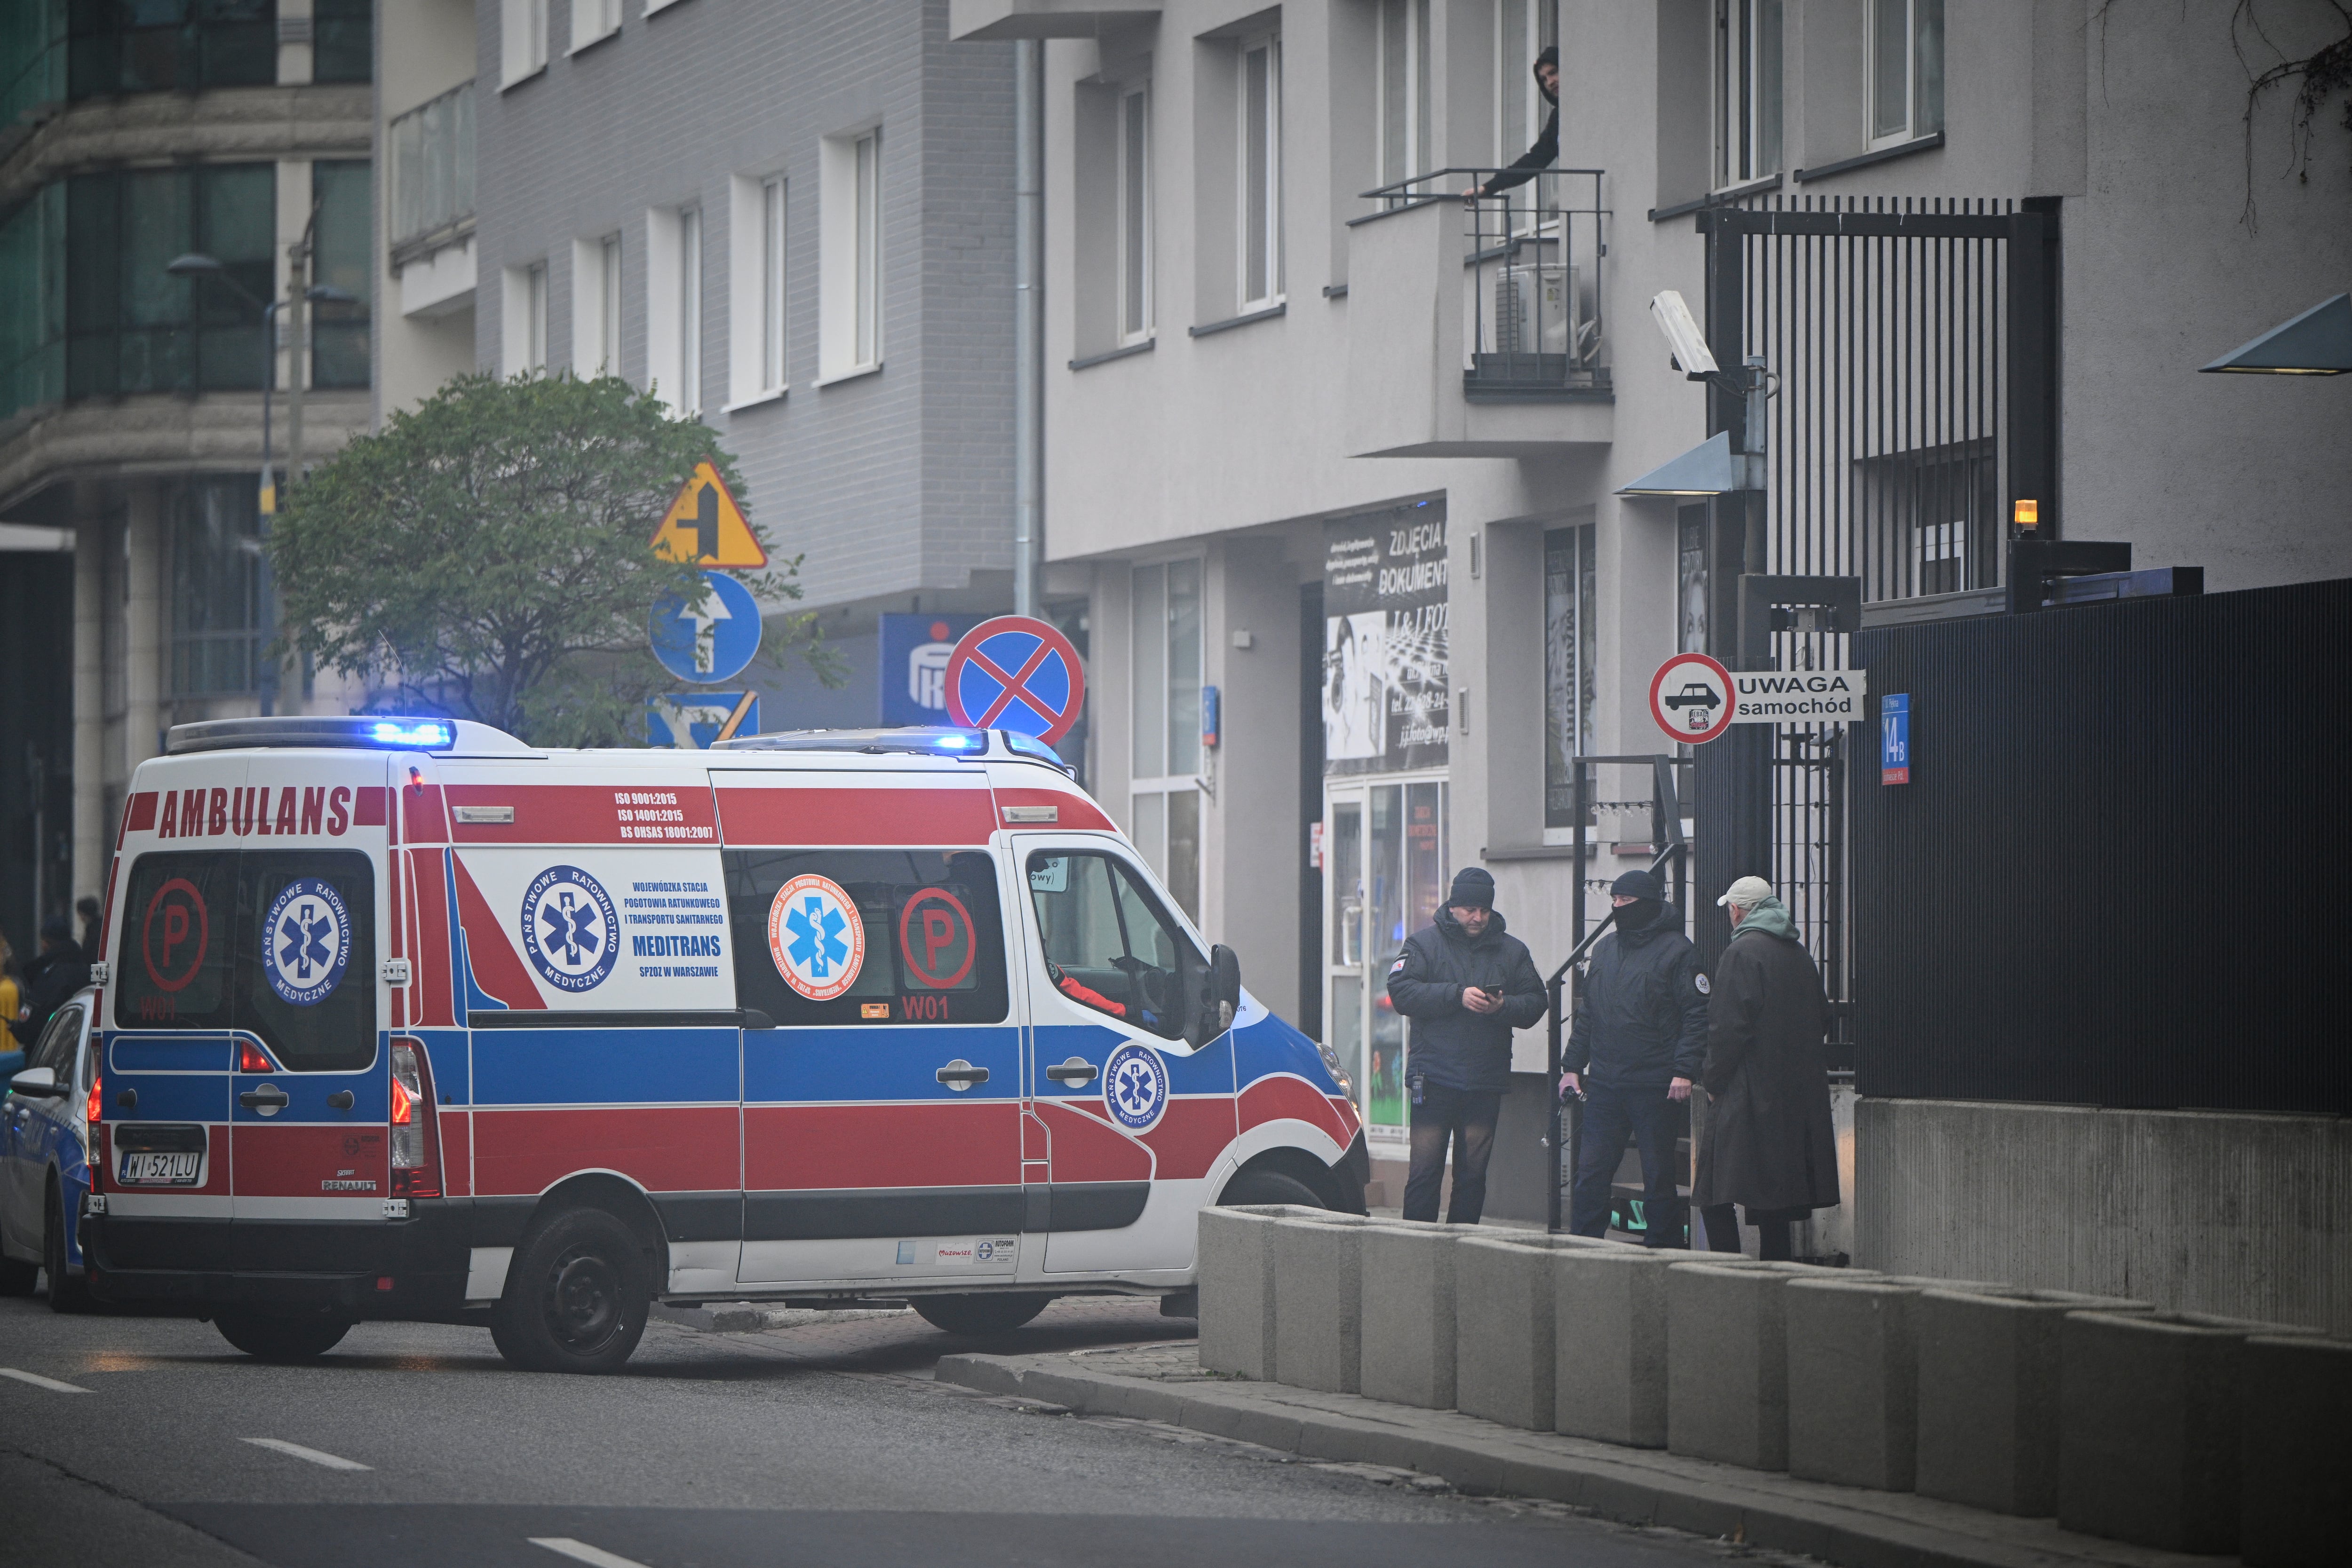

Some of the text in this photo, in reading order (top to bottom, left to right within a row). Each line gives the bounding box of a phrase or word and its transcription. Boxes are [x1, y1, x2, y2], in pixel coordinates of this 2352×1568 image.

[1389, 523, 1441, 558] ZDJĘCIA
[1566, 609, 1574, 751] MANICURE
[1739, 676, 1849, 695] UWAGA
[1739, 697, 1851, 715] samochód
[615, 793, 677, 805] ISO 9001:2015
[159, 786, 350, 839] AMBULANS
[618, 809, 683, 821] ISO 14001:2015
[620, 826, 713, 838] BS OHSAS 18001:2007
[633, 880, 708, 892] WOJEWÓDZKA STACJA
[781, 884, 795, 901] STACJA
[795, 879, 820, 888] POGOTOWIA
[624, 898, 720, 908] POGOTOWIA RATUNKOWEGO
[822, 881, 851, 911] RATUNKOWEGO
[523, 871, 617, 954] PAŃSTWOWE RATOWNICTWO
[625, 914, 723, 924] I TRANSPORTU SANITARNEGO
[771, 900, 783, 938] WOJEWÓDZKA
[263, 883, 349, 966] PAŃSTWOWE RATOWNICTWO
[851, 915, 861, 952] TRANSPORTU
[163, 905, 188, 967] P
[633, 935, 721, 957] MEDITRANS
[922, 909, 954, 971] P
[639, 966, 718, 977] SPZOZ W WARSZAWIE
[774, 946, 791, 979] WARSZAWIE
[842, 954, 860, 986] SANITARNEGO
[545, 966, 605, 988] MEDYCZNE
[797, 982, 810, 994] SPZOZ
[277, 980, 332, 1001] MEDYCZNE
[141, 997, 175, 1020] W01
[902, 996, 948, 1020] W01
[1108, 1051, 1163, 1103] PAŃSTWOWE RATOWNICTWO
[1119, 1109, 1154, 1124] MEDYCZNE
[323, 1181, 376, 1190] RENAULT
